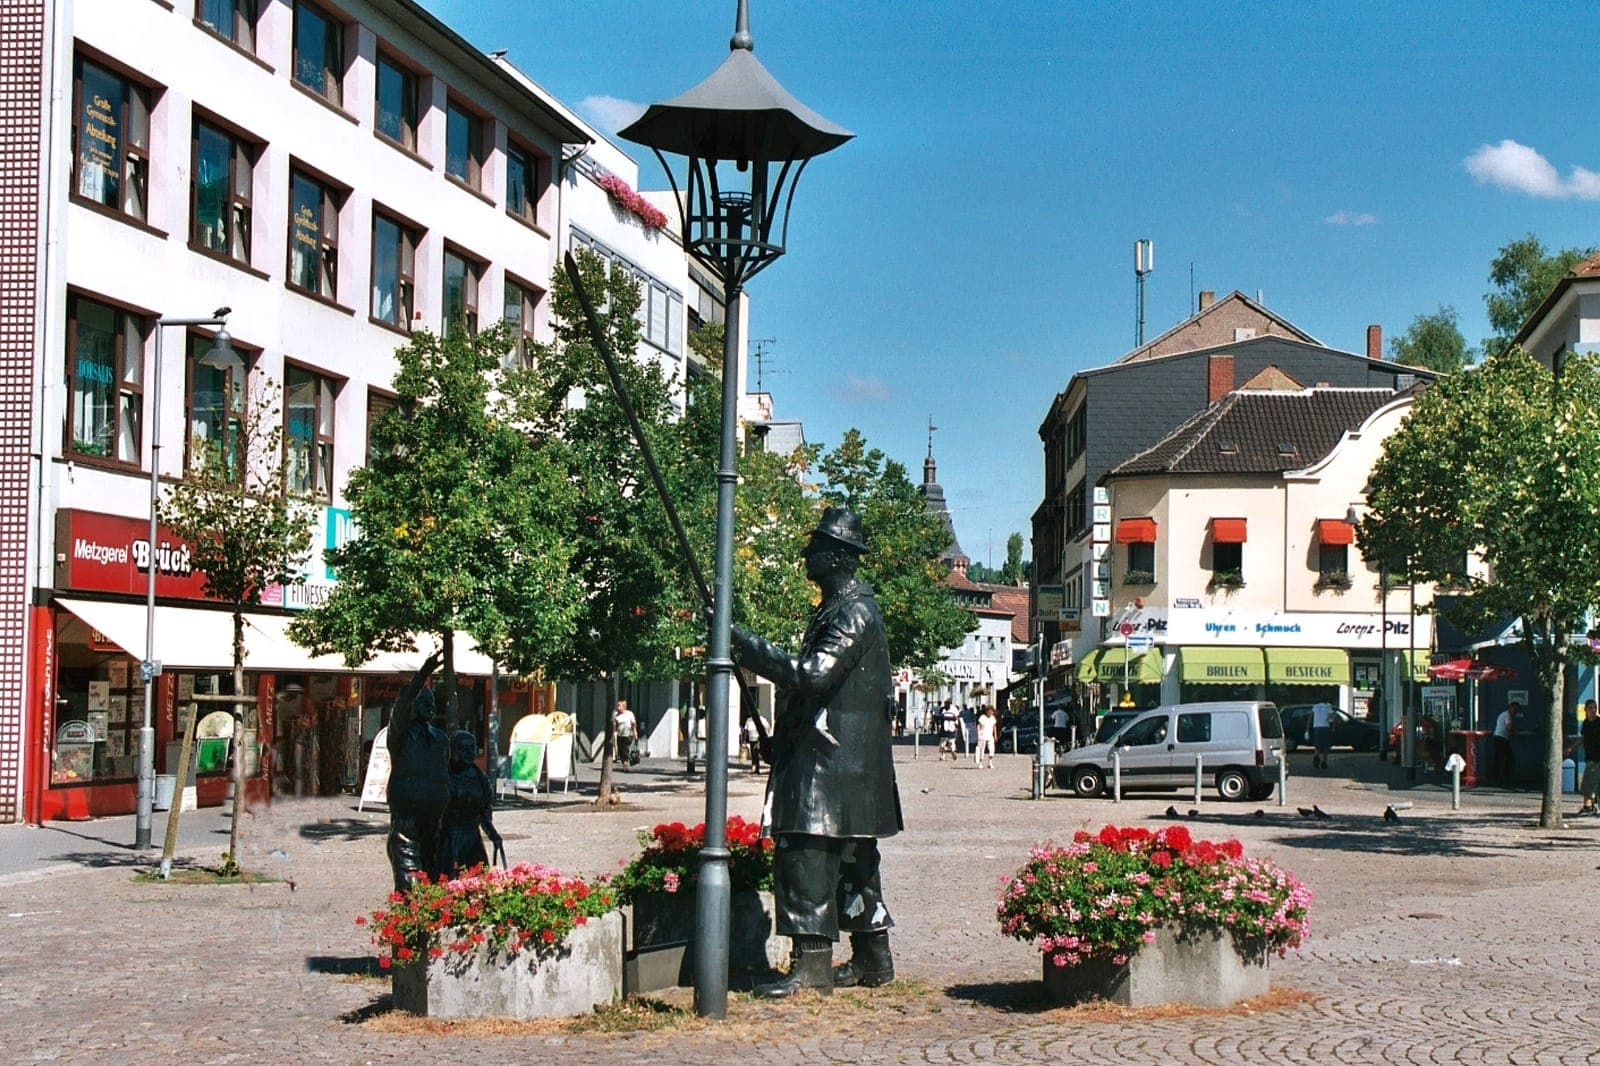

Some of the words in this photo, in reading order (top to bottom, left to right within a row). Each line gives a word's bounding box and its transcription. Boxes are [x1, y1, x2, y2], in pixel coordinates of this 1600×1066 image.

[74, 539, 128, 565] Metzgerei
[1096, 488, 1108, 613] BRILLEN
[1205, 623, 1236, 632] Uhren
[1256, 623, 1302, 632] Schmuck
[1207, 666, 1248, 676] BRILLEN
[1285, 666, 1333, 677] BESTECKE
